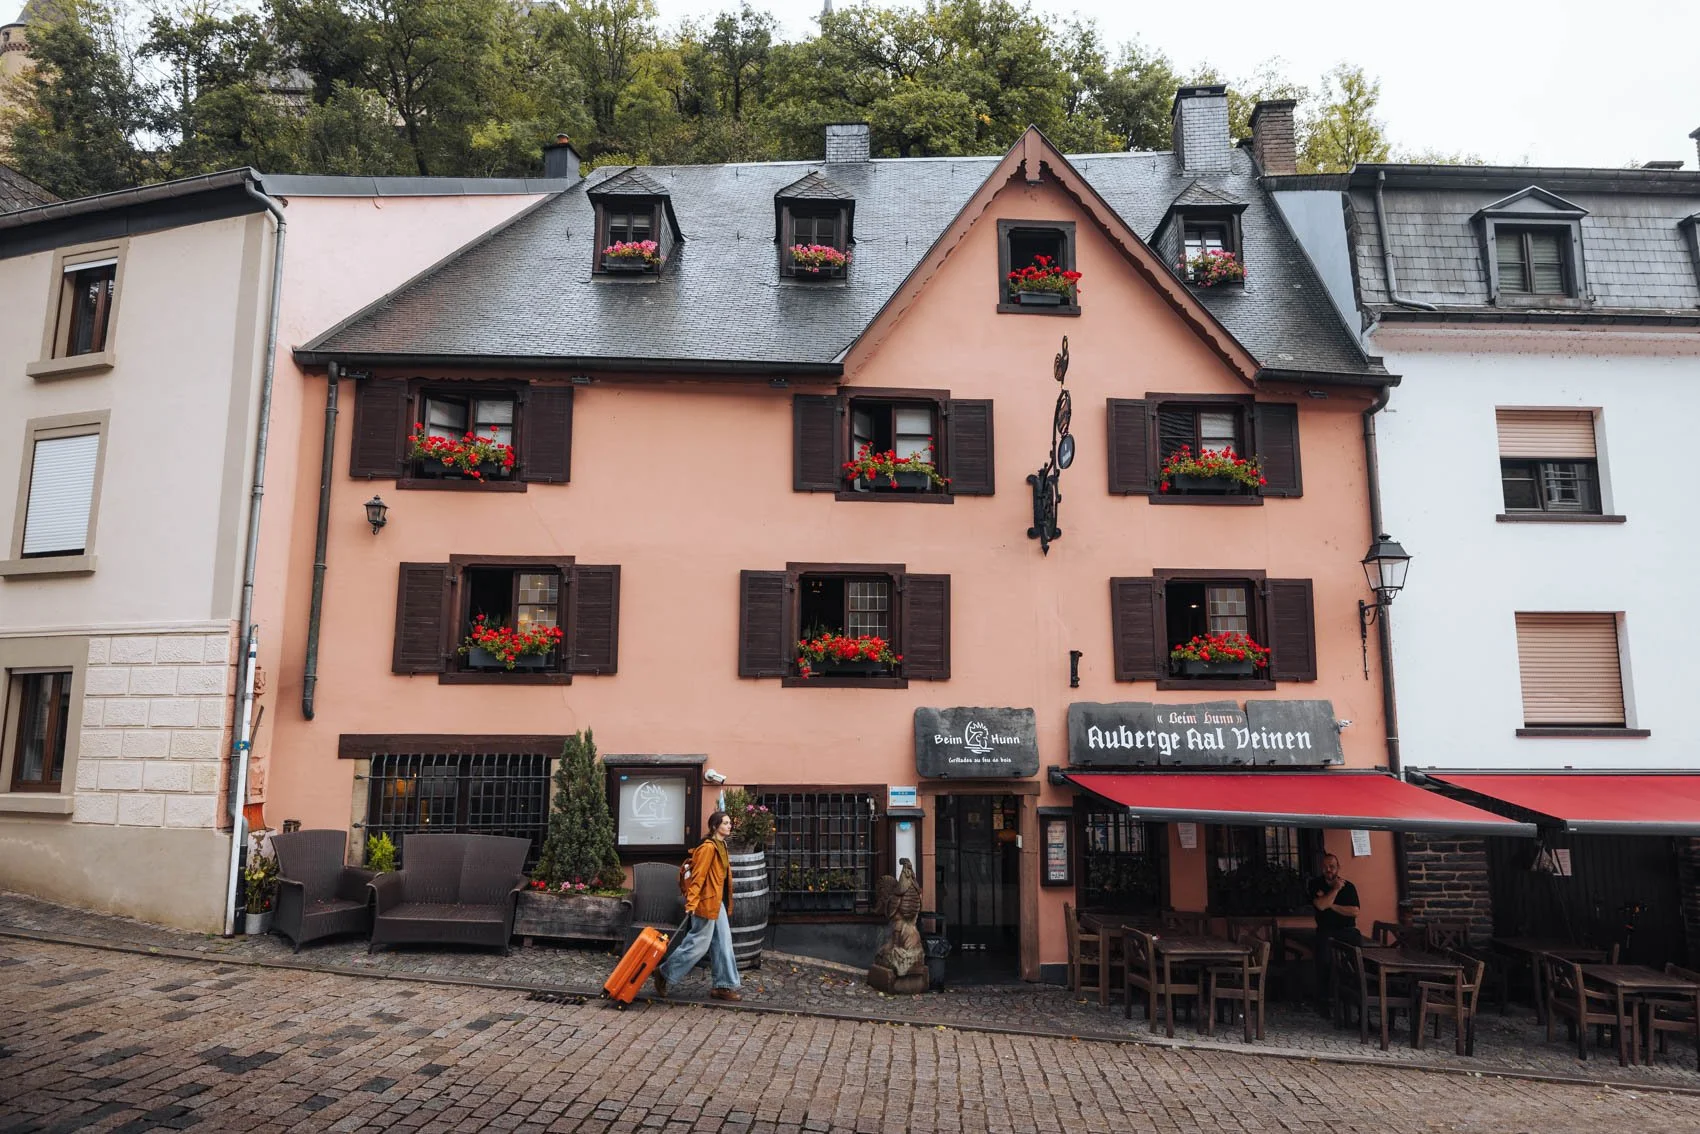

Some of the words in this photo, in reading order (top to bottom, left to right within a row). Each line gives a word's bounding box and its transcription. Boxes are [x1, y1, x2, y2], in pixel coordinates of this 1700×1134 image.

[1169, 711, 1198, 725] Beim
[934, 734, 963, 745] Beim
[991, 733, 1021, 745] Hunn
[1087, 725, 1181, 756] Auberge
[1186, 727, 1226, 751] Aal
[1231, 725, 1312, 750] Veinen
